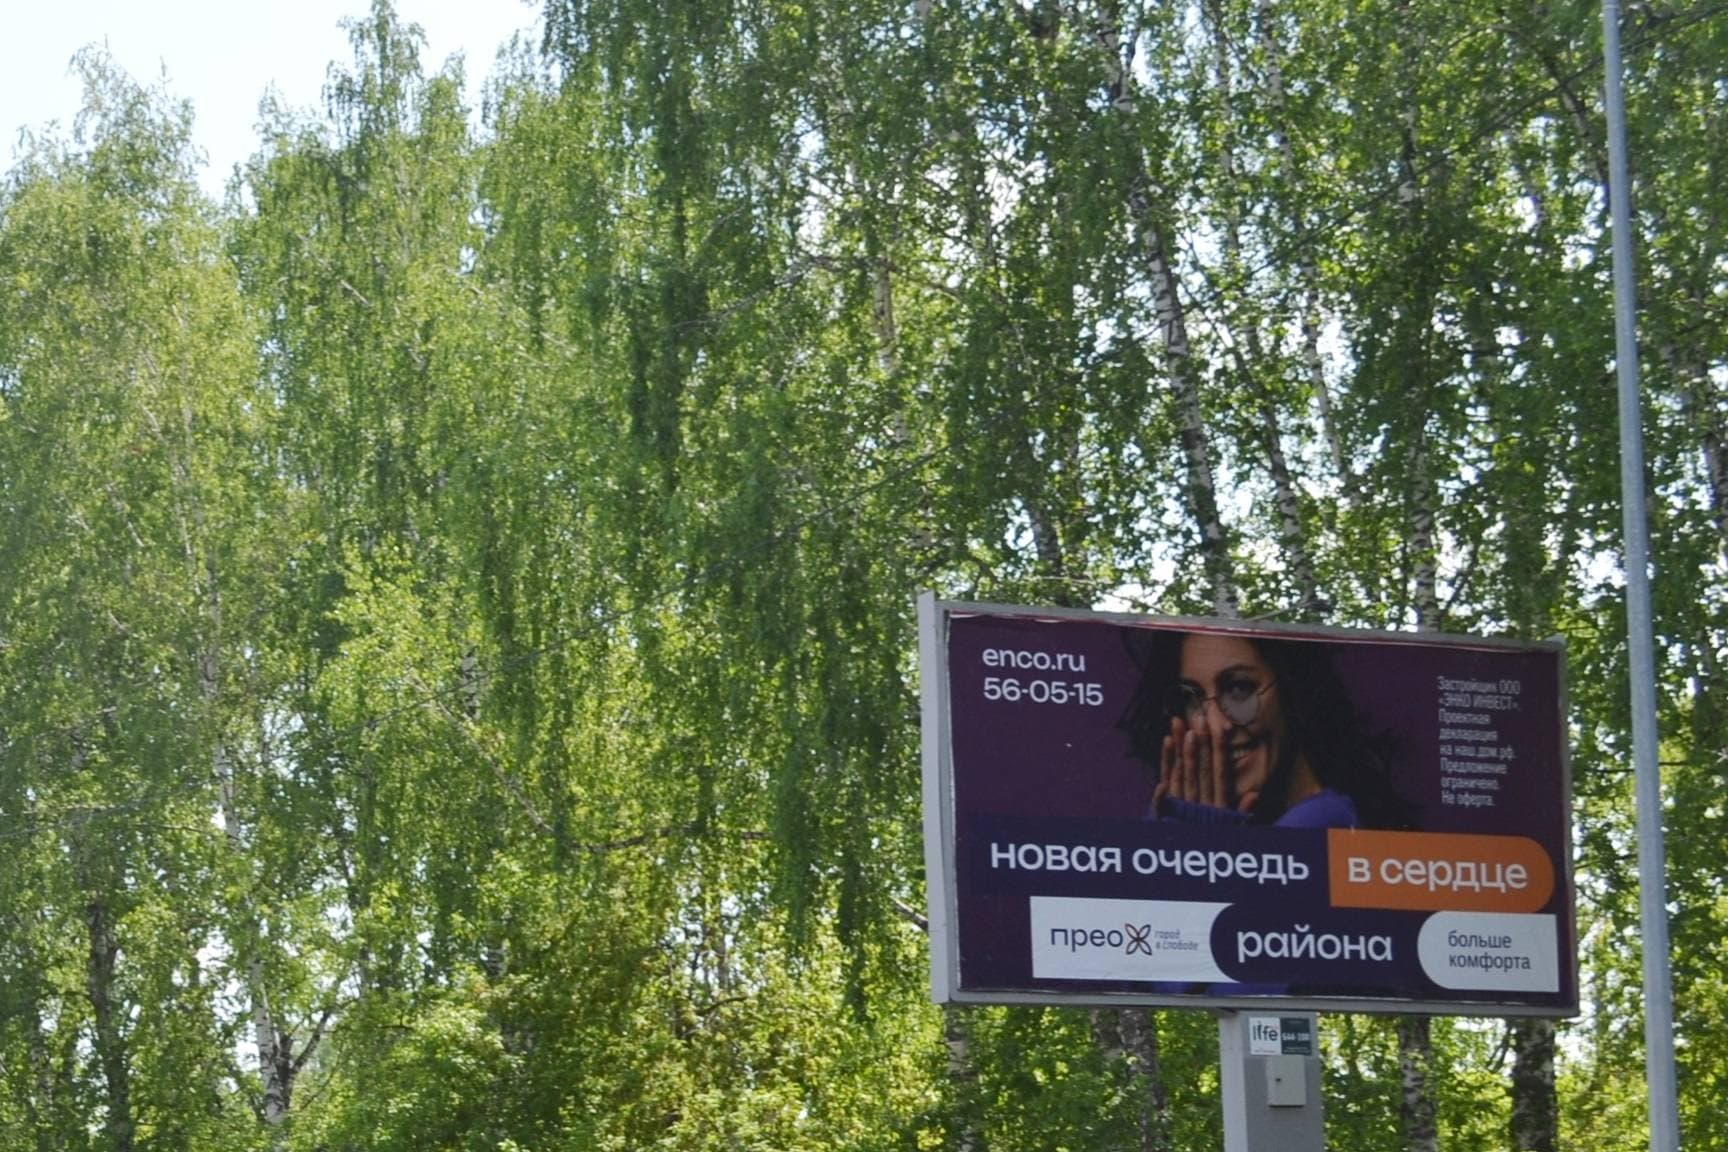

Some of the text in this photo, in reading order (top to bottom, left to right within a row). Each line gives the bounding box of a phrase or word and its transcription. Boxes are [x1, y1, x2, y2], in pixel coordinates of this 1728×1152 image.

[982, 648, 1086, 672] enco.ru
[983, 676, 1104, 706] 56-05-15
[1498, 679, 1521, 695] ООО
[990, 843, 1528, 893] новая очередь в сердце
[1050, 928, 1124, 953] прео
[1237, 924, 1394, 963] района
[1447, 930, 1513, 949] больше
[1448, 953, 1532, 973] комфорта
